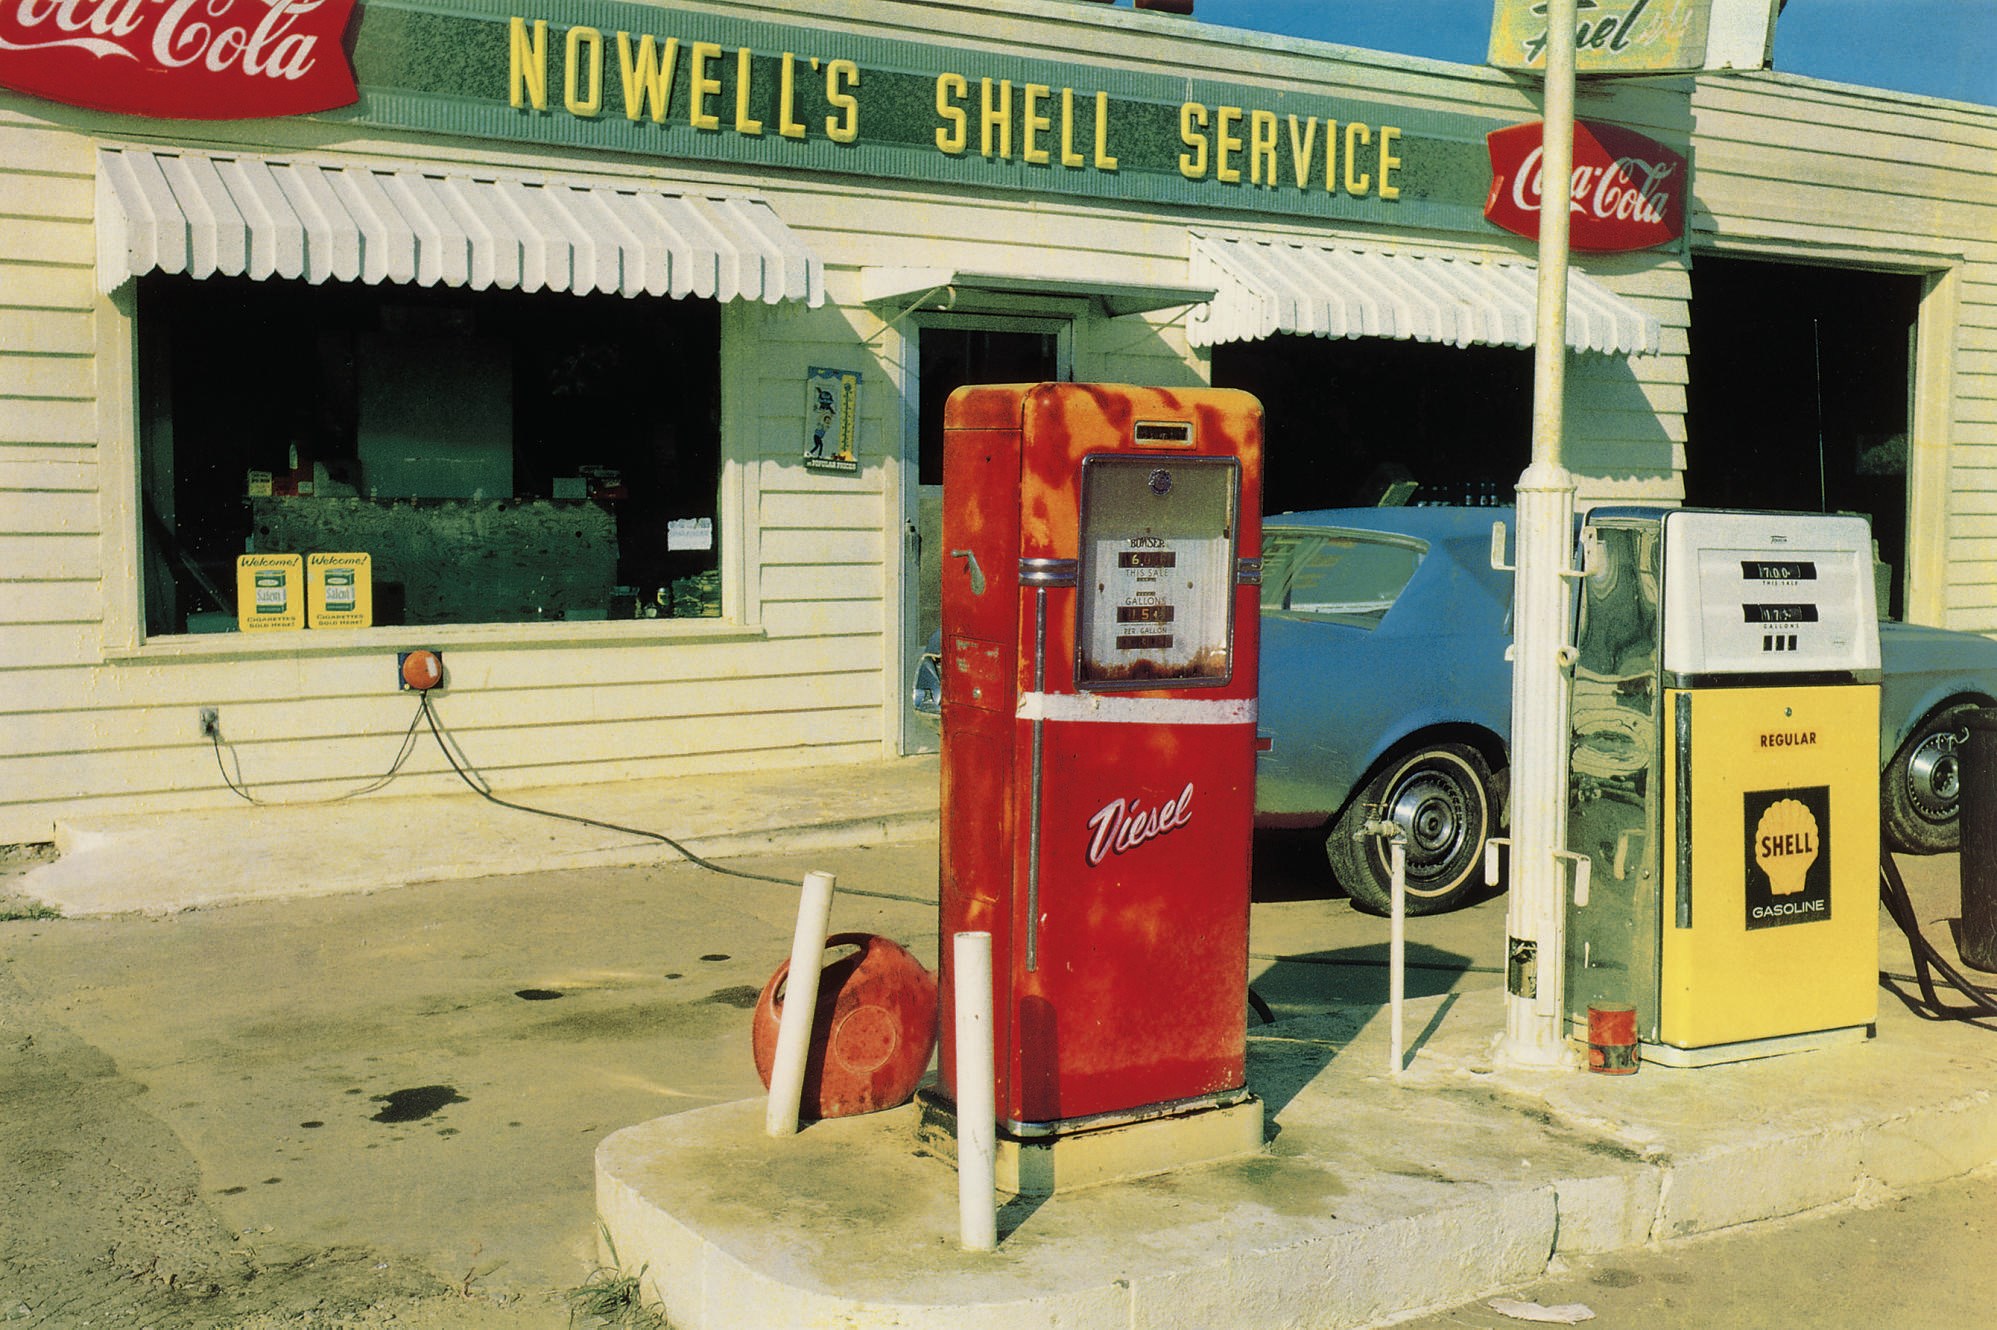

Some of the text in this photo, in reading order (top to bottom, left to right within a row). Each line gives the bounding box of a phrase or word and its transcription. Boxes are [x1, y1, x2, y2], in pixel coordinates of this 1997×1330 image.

[510, 17, 1401, 200] NOWELL'S SHELL SERVICE
[241, 557, 299, 567] Welcome!
[311, 556, 368, 565] Welcome!
[1126, 569, 1169, 577] THIS SALE
[1760, 732, 1817, 748] REGULAR
[1086, 782, 1194, 867] Diesel
[1761, 832, 1813, 858] SHELL
[1752, 899, 1825, 919] GASOLINE
